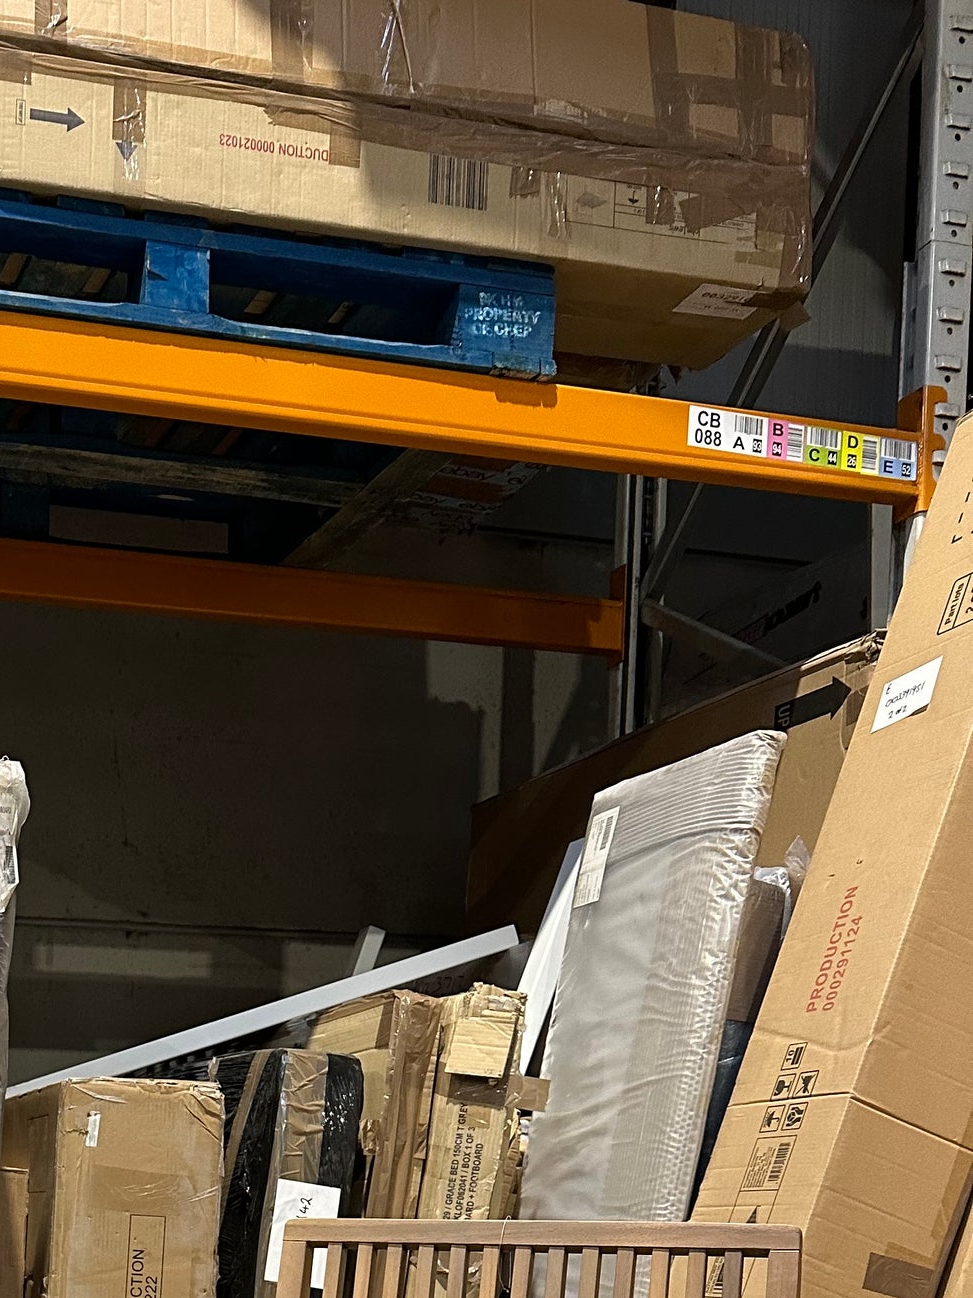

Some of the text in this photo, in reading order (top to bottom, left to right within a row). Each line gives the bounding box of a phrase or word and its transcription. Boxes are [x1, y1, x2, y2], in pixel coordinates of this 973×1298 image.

[278, 144, 330, 162] DUCTION
[493, 322, 532, 337] CHEP
[697, 410, 721, 428] CB
[694, 428, 722, 447] 088
[772, 423, 784, 437] B
[732, 436, 745, 450] A
[752, 440, 762, 452] 93
[772, 442, 782, 455] 94
[847, 435, 858, 449] D
[808, 448, 820, 462] C
[827, 452, 837, 464] 44
[847, 456, 857, 467] 26
[883, 461, 893, 473] E
[901, 463, 911, 476] 52
[777, 704, 791, 728] UP
[805, 885, 859, 1014] PRODUCTION
[822, 915, 864, 1012] 000291124
[458, 1102, 468, 1125] GREY
[453, 1133, 464, 1158] 150CM
[450, 1159, 459, 1176] BED
[461, 1151, 471, 1169] BOX
[468, 1143, 484, 1193] FOOTBOARD
[445, 1177, 456, 1205] GRACE
